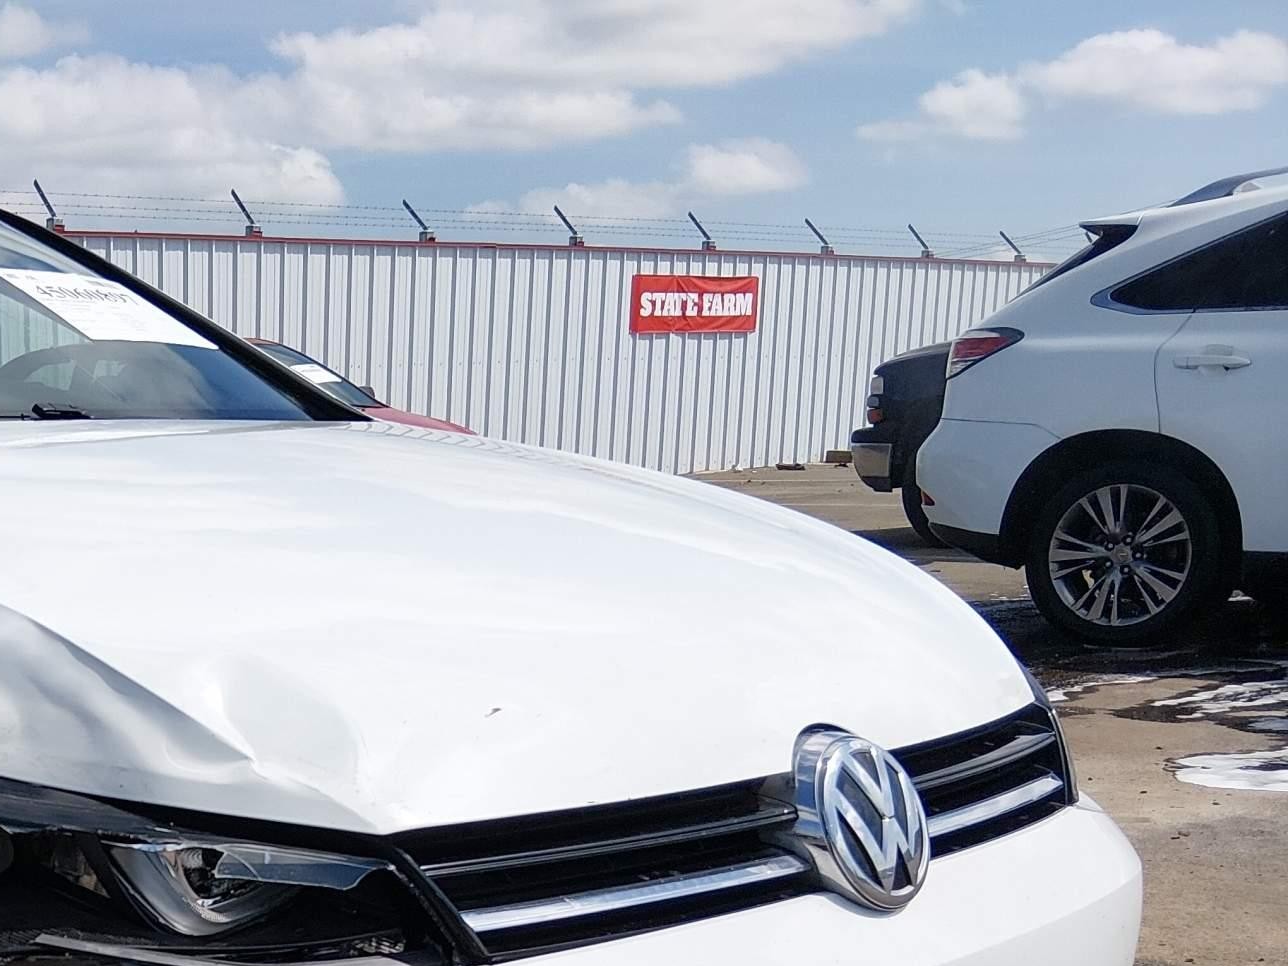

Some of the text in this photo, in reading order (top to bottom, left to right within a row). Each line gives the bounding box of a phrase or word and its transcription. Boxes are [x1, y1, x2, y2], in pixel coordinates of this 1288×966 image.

[639, 291, 754, 317] STATE FARM
[824, 742, 922, 897] VW
